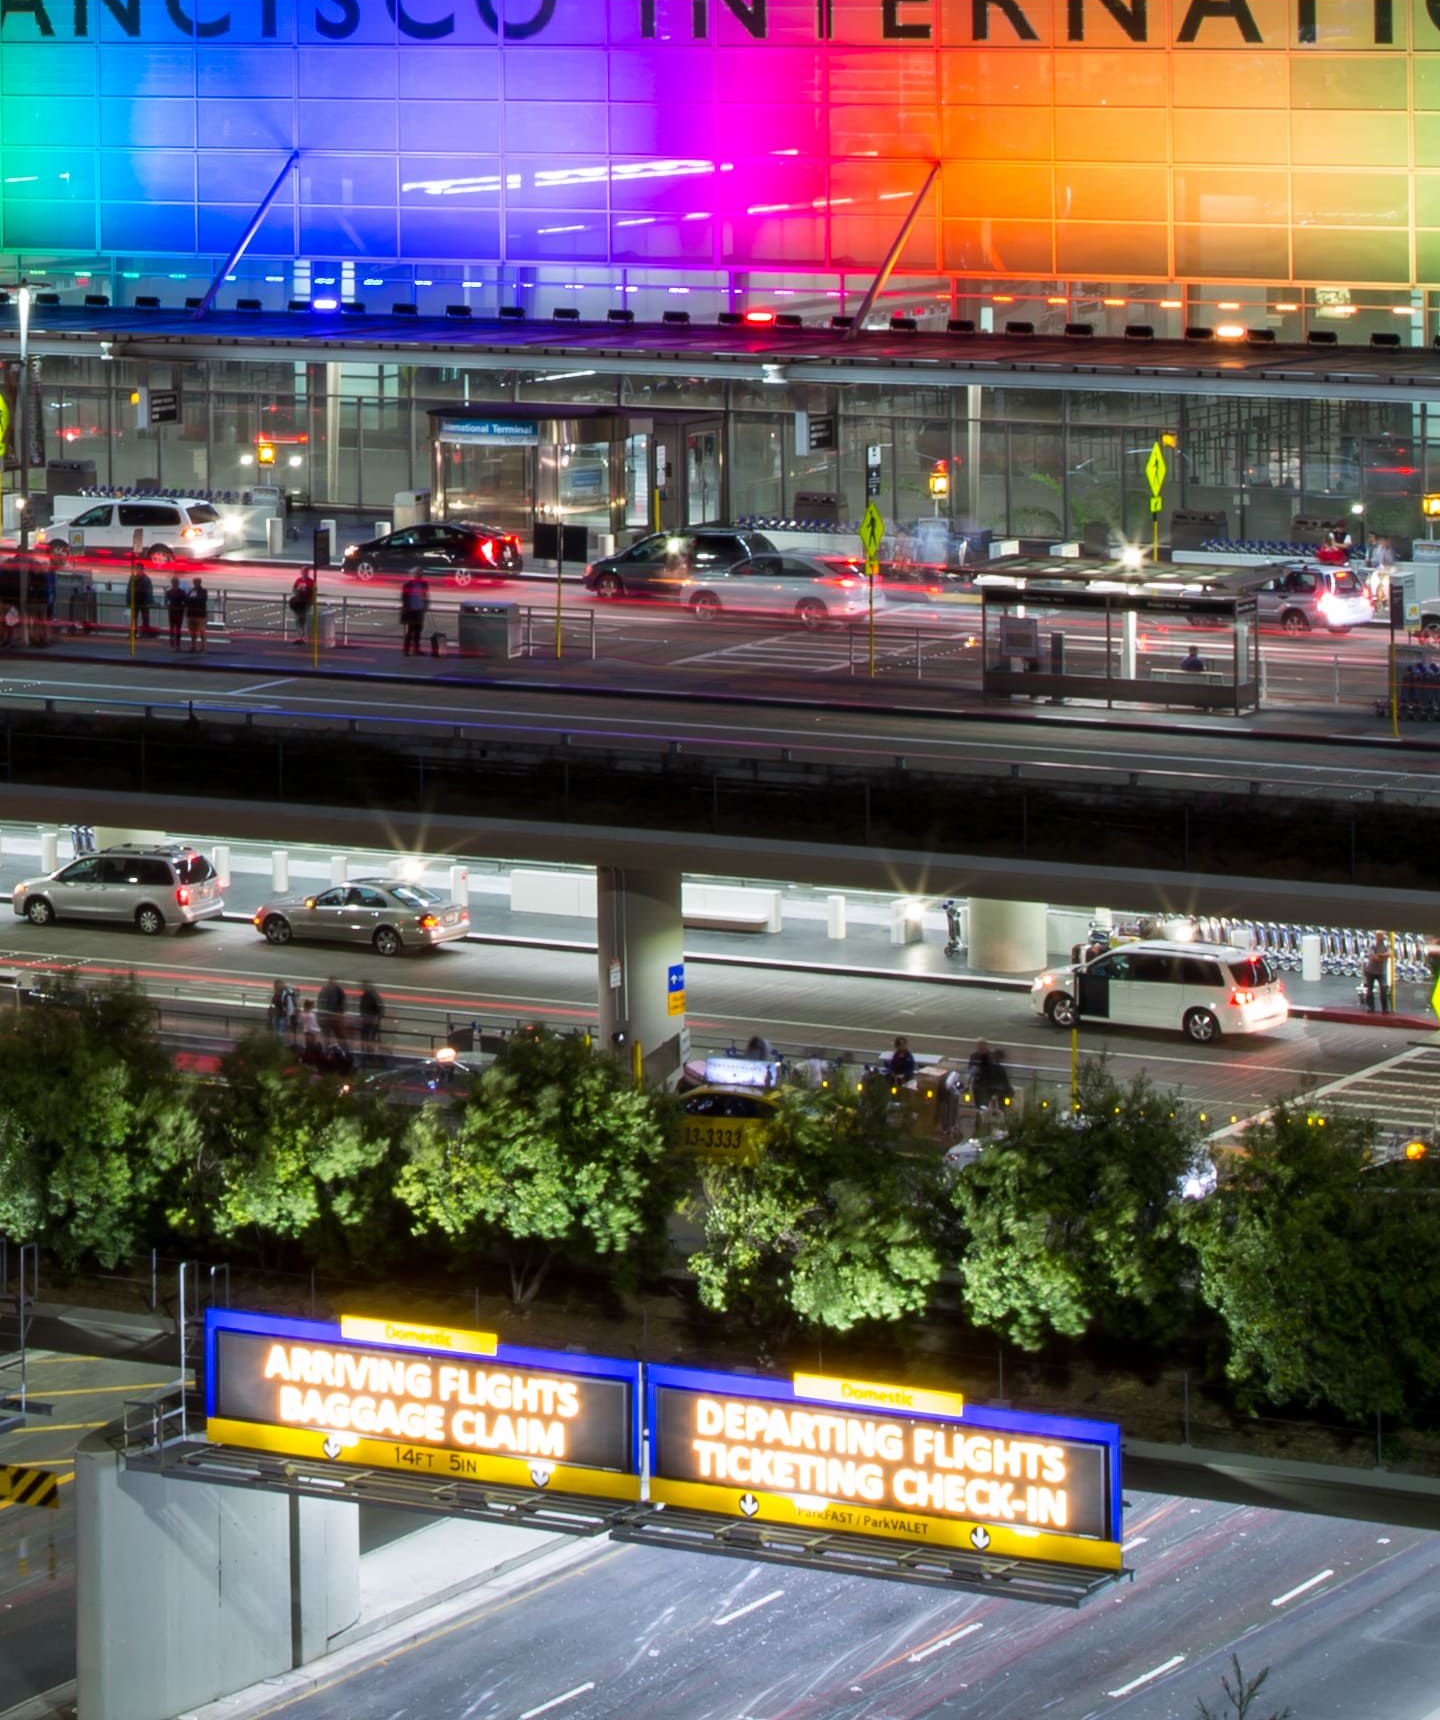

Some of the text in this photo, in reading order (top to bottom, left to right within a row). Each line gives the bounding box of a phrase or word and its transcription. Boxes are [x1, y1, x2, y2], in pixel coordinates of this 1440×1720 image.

[385, 1323, 453, 1347] Domestic
[264, 1344, 580, 1418] ARRIVING FLIGHTS
[841, 1382, 914, 1408] Domestic
[279, 1386, 565, 1458] BAGGAGE CLAIM
[696, 1398, 1066, 1483] DEPARTING FLIGHTS
[394, 1446, 477, 1474] 14FT 5IN
[692, 1439, 1068, 1527] TICKETING CHECK-IN
[863, 1514, 929, 1535] ParkVALET
